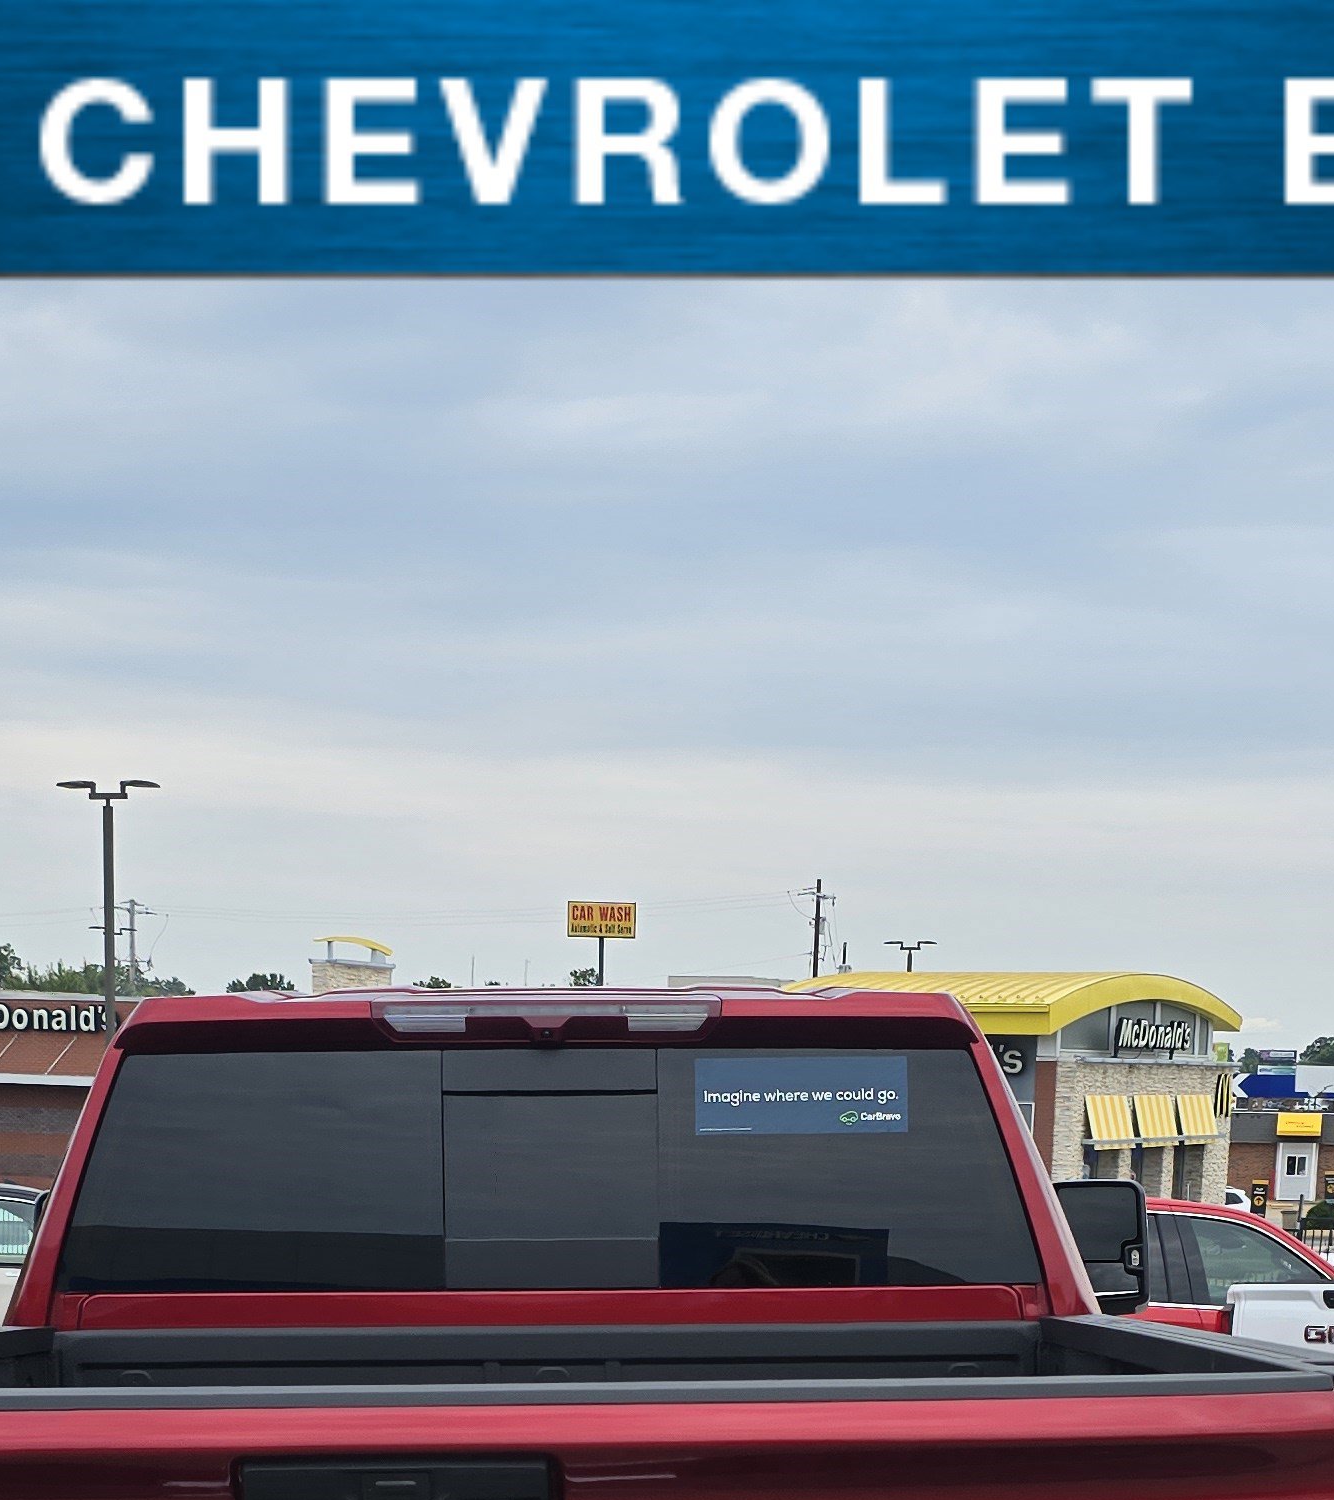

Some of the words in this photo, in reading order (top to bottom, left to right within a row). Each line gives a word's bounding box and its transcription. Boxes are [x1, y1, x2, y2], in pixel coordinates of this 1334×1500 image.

[572, 905, 593, 921] CAR
[599, 906, 631, 922] WASH
[1118, 1018, 1191, 1048] McDonald's
[703, 1089, 761, 1106] Imagine
[764, 1089, 809, 1102] where
[811, 1091, 833, 1101] we
[835, 1088, 874, 1101] could
[877, 1091, 899, 1104] go.
